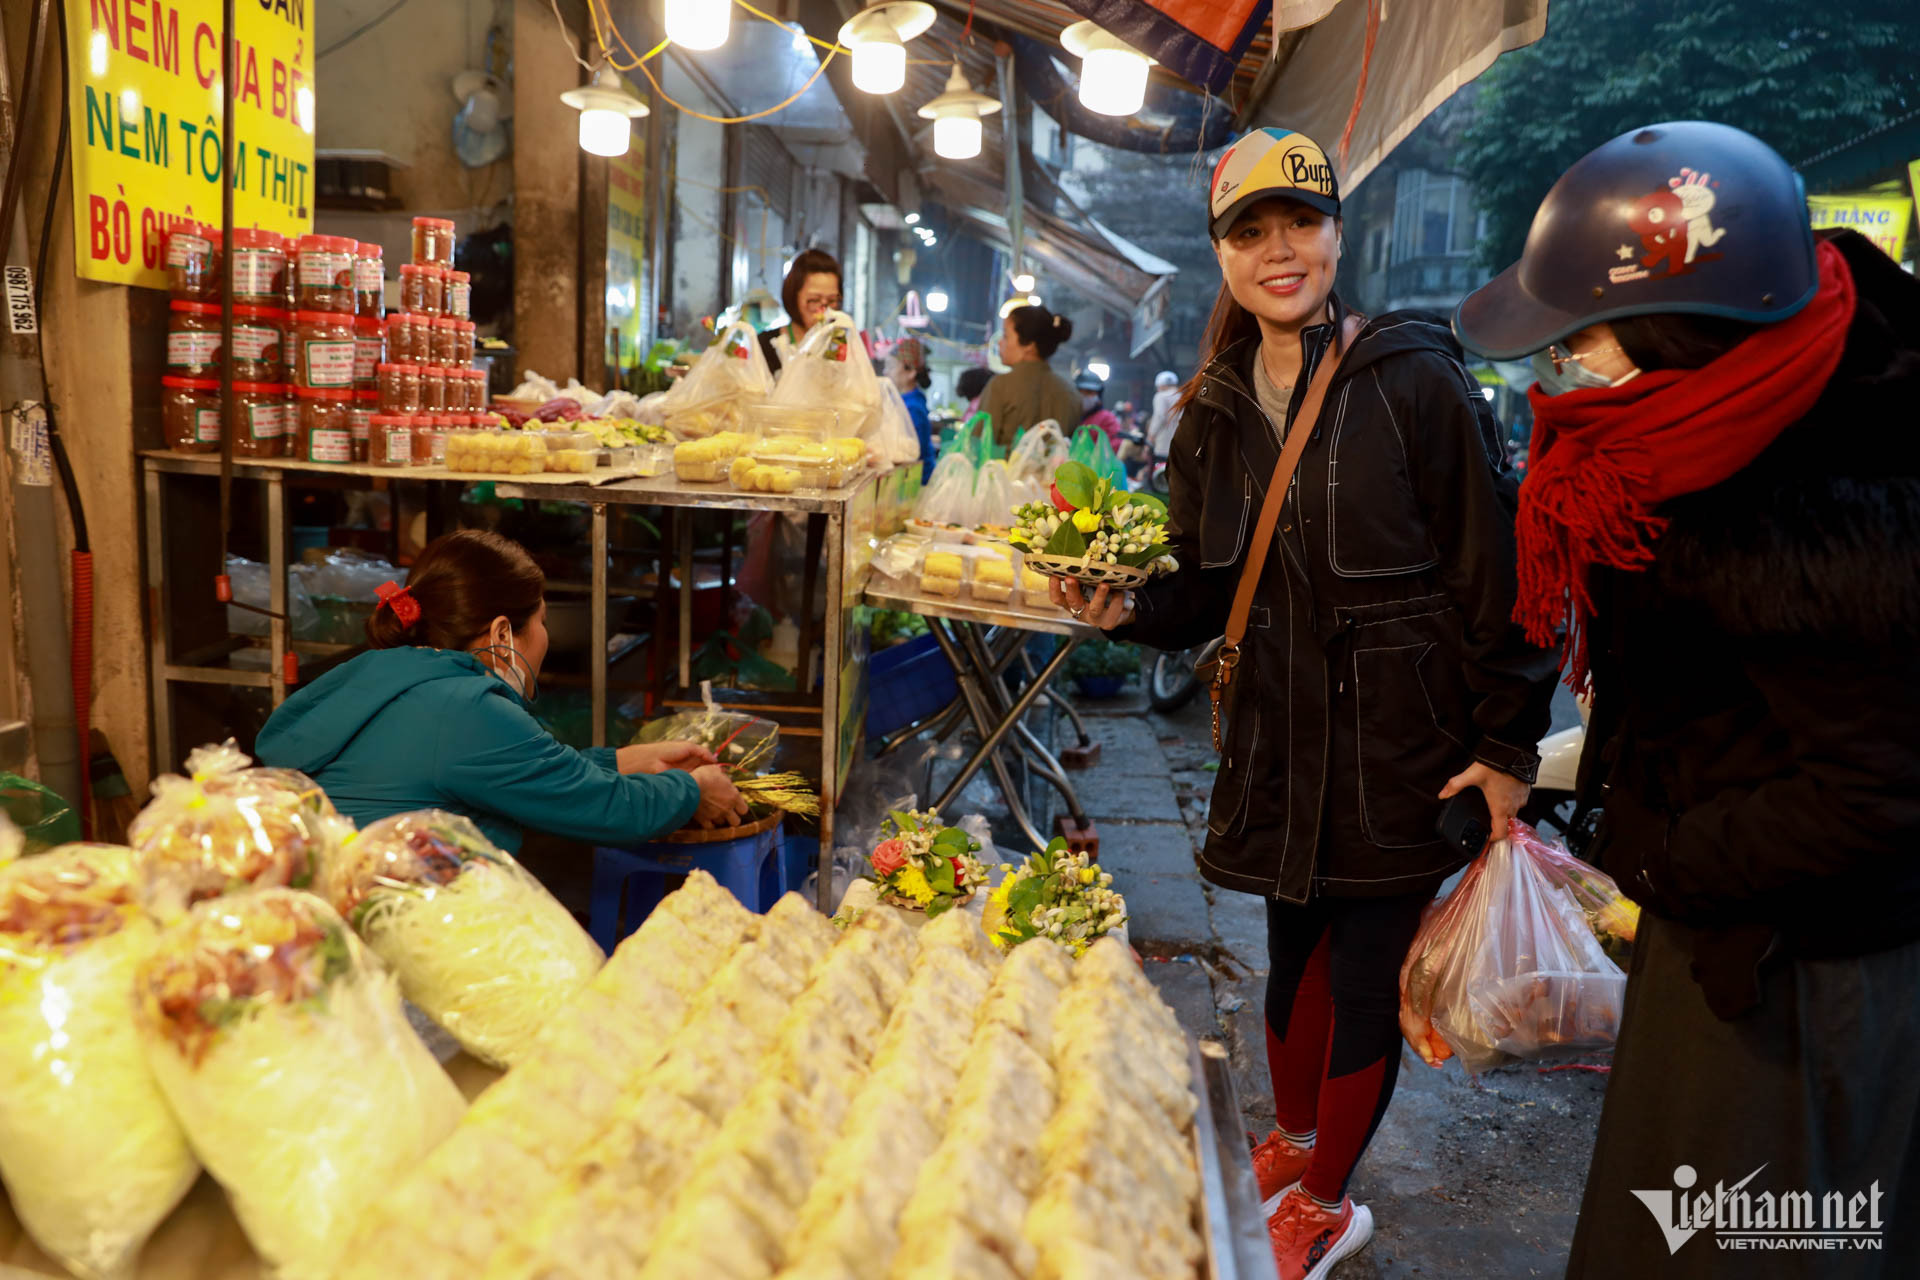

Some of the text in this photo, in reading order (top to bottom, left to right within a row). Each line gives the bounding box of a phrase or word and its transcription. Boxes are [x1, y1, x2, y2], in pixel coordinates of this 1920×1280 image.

[90, 0, 179, 76] NEM
[85, 84, 308, 218] NEM TÔM THỊT
[89, 184, 131, 265] BÒ
